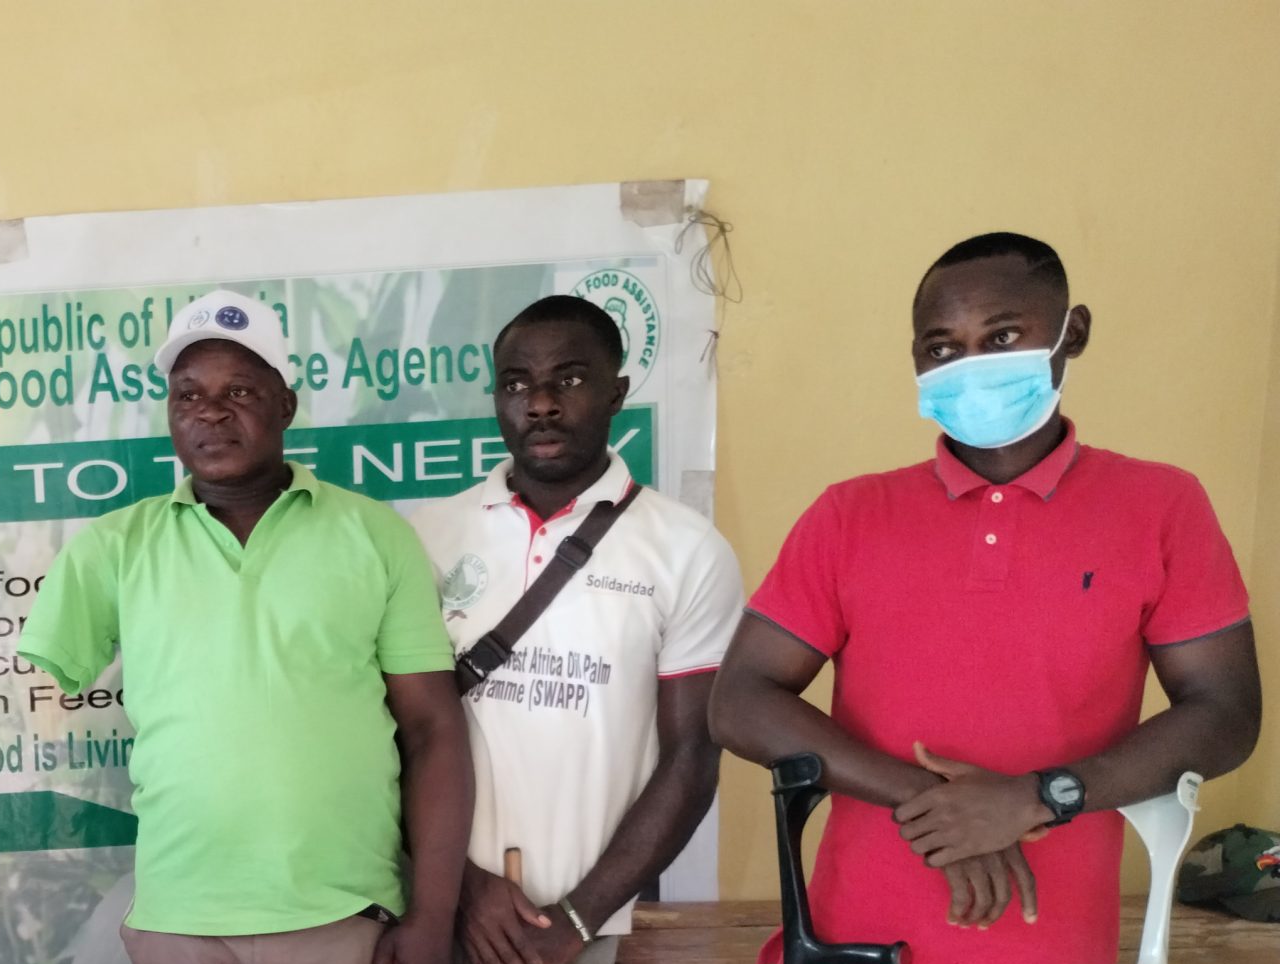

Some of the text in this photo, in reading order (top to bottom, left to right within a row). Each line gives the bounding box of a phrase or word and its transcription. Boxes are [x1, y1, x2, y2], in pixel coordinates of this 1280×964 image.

[585, 273, 619, 293] FOOD
[118, 296, 154, 348] of
[89, 350, 329, 406] Assce
[343, 338, 497, 400] Agency
[13, 459, 129, 503] TO
[586, 574, 655, 597] Solidaridad
[529, 647, 564, 677] Africa
[583, 653, 611, 685] Palm
[528, 679, 590, 718] (SWAPP)
[33, 734, 58, 772] is
[67, 729, 137, 770] Livin
